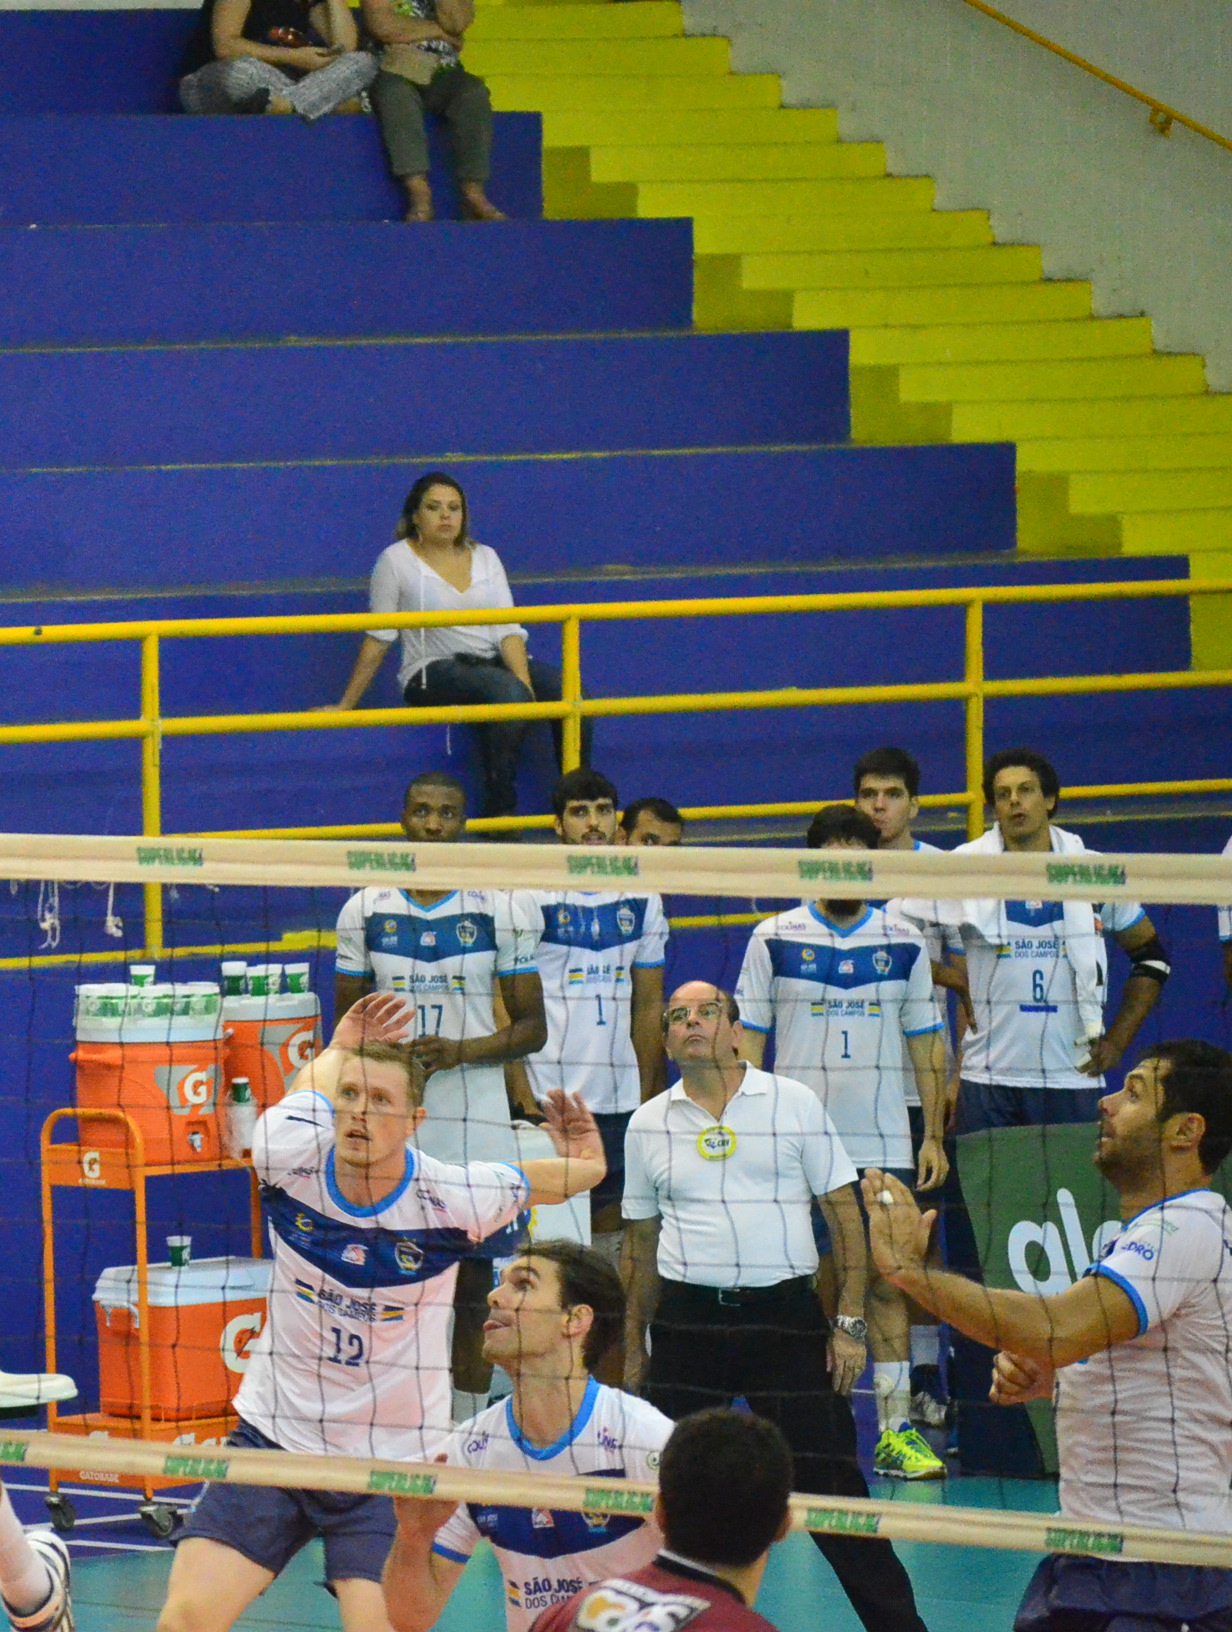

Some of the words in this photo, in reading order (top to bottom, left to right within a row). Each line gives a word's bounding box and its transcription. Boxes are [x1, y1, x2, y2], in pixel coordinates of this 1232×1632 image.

[1015, 939, 1033, 950] SÃO
[1032, 969, 1044, 1003] 6
[417, 1003, 444, 1038] 17
[595, 993, 607, 1026] 1
[827, 999, 843, 1009] SÃO
[287, 1030, 315, 1069] G
[840, 1030, 851, 1059] 1
[184, 1071, 207, 1104] G
[83, 1151, 100, 1178] G
[220, 1312, 263, 1374] G
[327, 1326, 365, 1368] 12
[524, 1577, 552, 1596] SÃO
[525, 1596, 549, 1610] DOS
